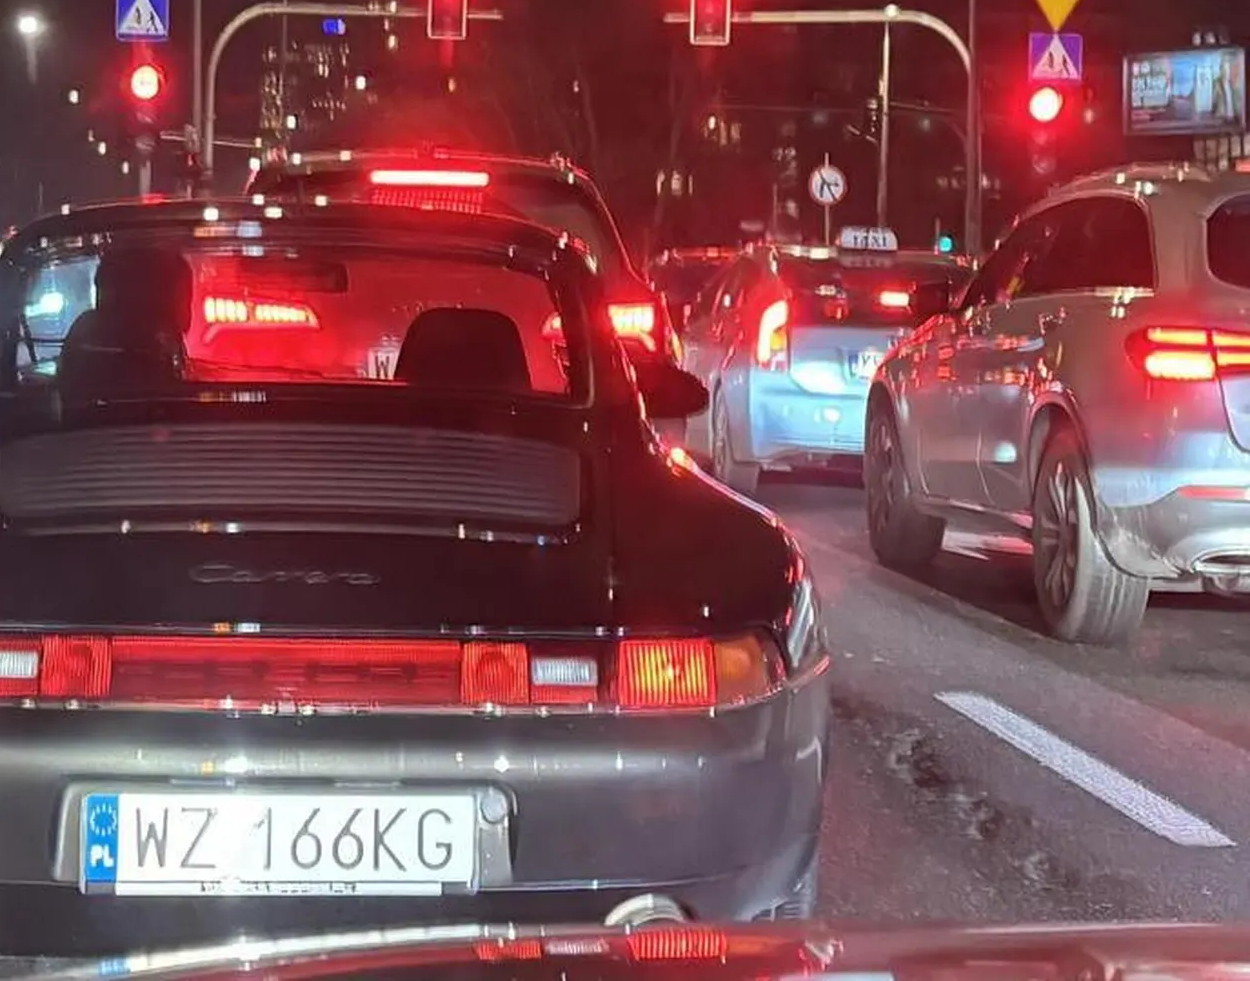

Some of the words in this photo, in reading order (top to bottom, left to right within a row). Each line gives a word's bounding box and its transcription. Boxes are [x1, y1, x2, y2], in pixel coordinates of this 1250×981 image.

[188, 564, 382, 586] Carrera
[135, 806, 218, 869] WZ
[253, 806, 454, 872] 166KG
[89, 844, 115, 869] PL
